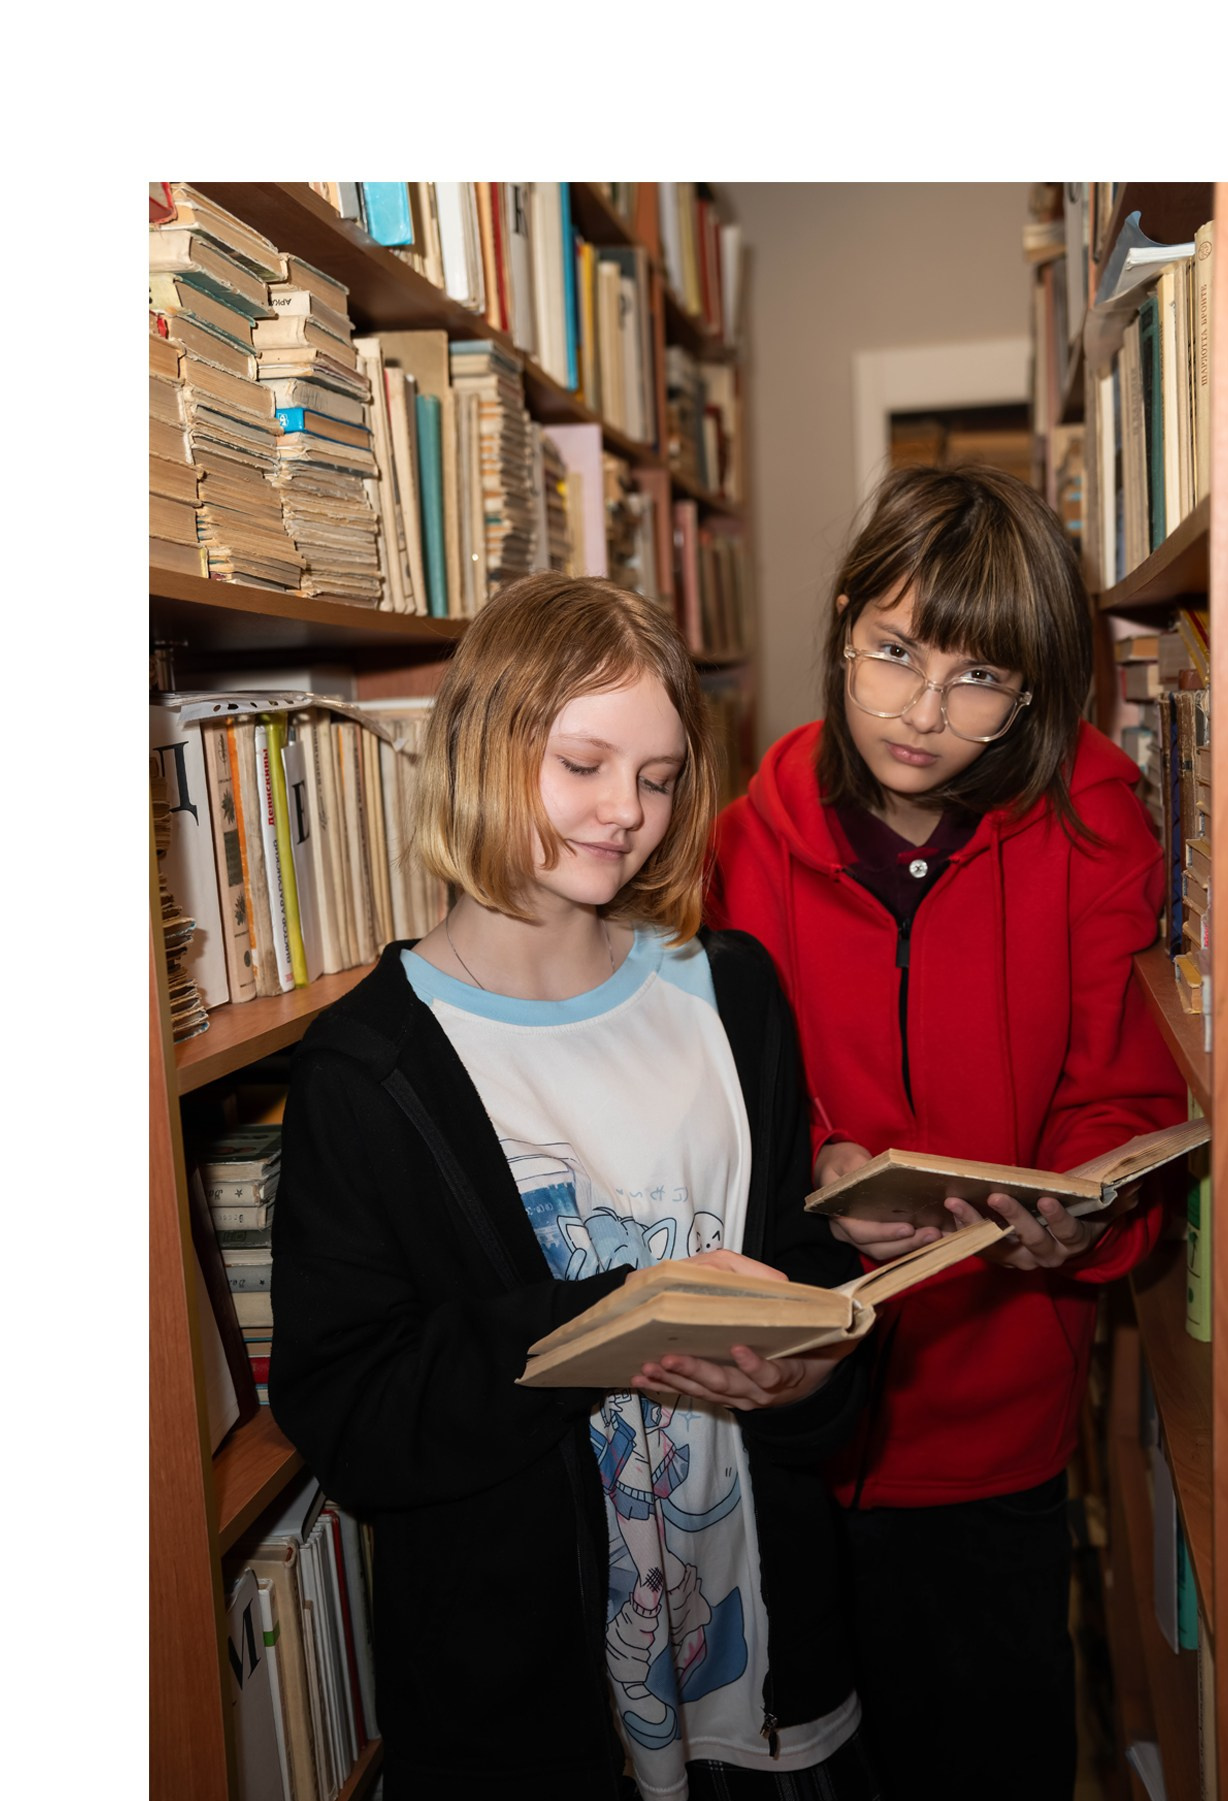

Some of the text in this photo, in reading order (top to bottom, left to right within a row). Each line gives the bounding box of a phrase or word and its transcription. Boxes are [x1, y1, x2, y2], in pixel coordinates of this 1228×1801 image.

[1200, 283, 1208, 386] ШАРЛОТТА БРОНТЕ
[262, 748, 276, 827] Денискины
